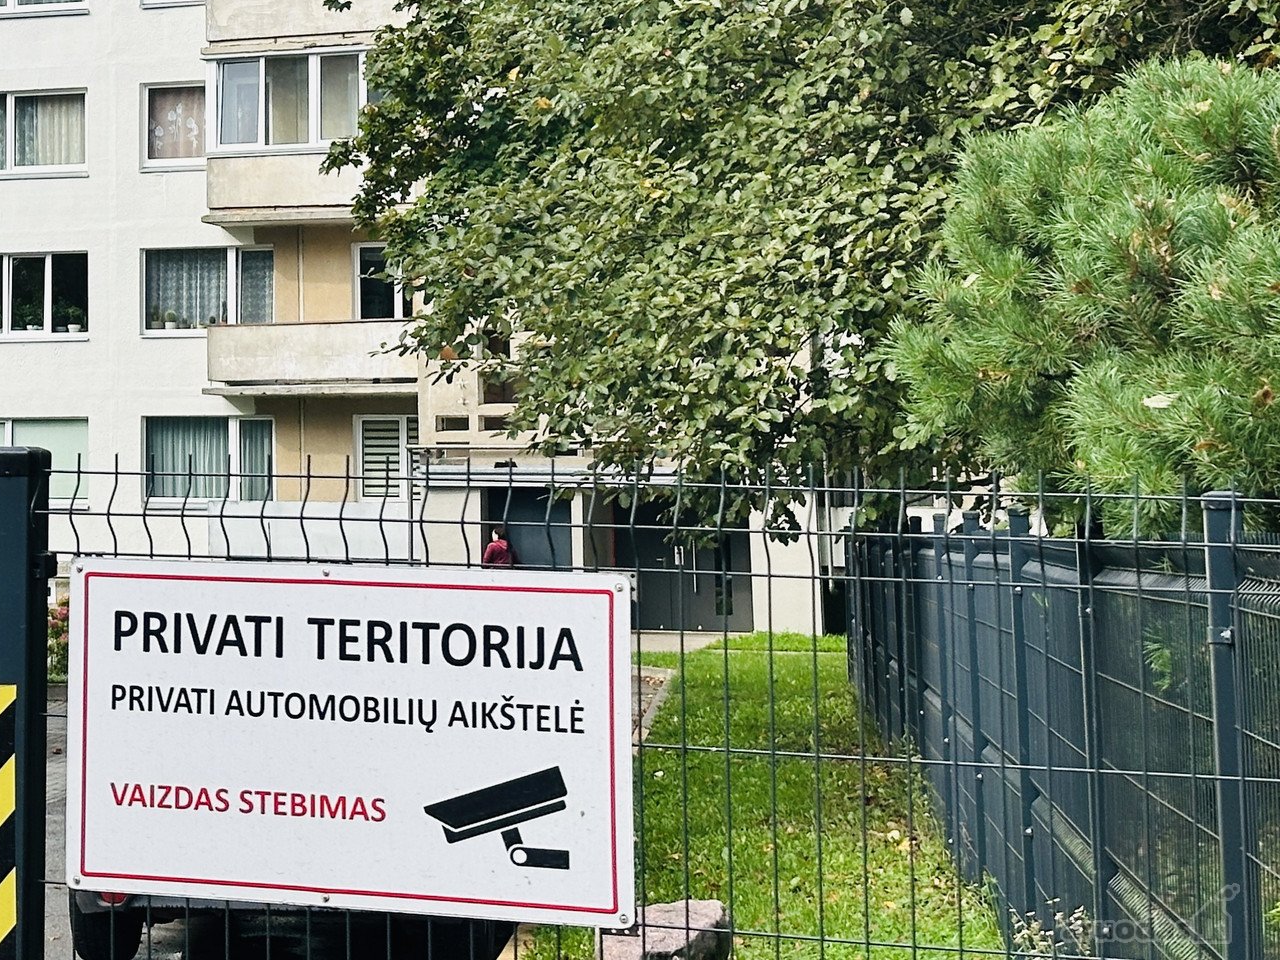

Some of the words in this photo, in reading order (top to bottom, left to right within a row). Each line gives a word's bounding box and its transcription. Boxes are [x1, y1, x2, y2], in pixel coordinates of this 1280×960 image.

[113, 610, 284, 659] PRIVATI
[307, 617, 584, 672] TERITORIJA
[111, 684, 215, 715] PRIVATI
[224, 689, 437, 734] AUTOMOBILIŲ
[448, 694, 585, 734] AIKŠTELĖ
[110, 782, 230, 813] VAIZDAS
[238, 789, 387, 823] STEBIMAS
